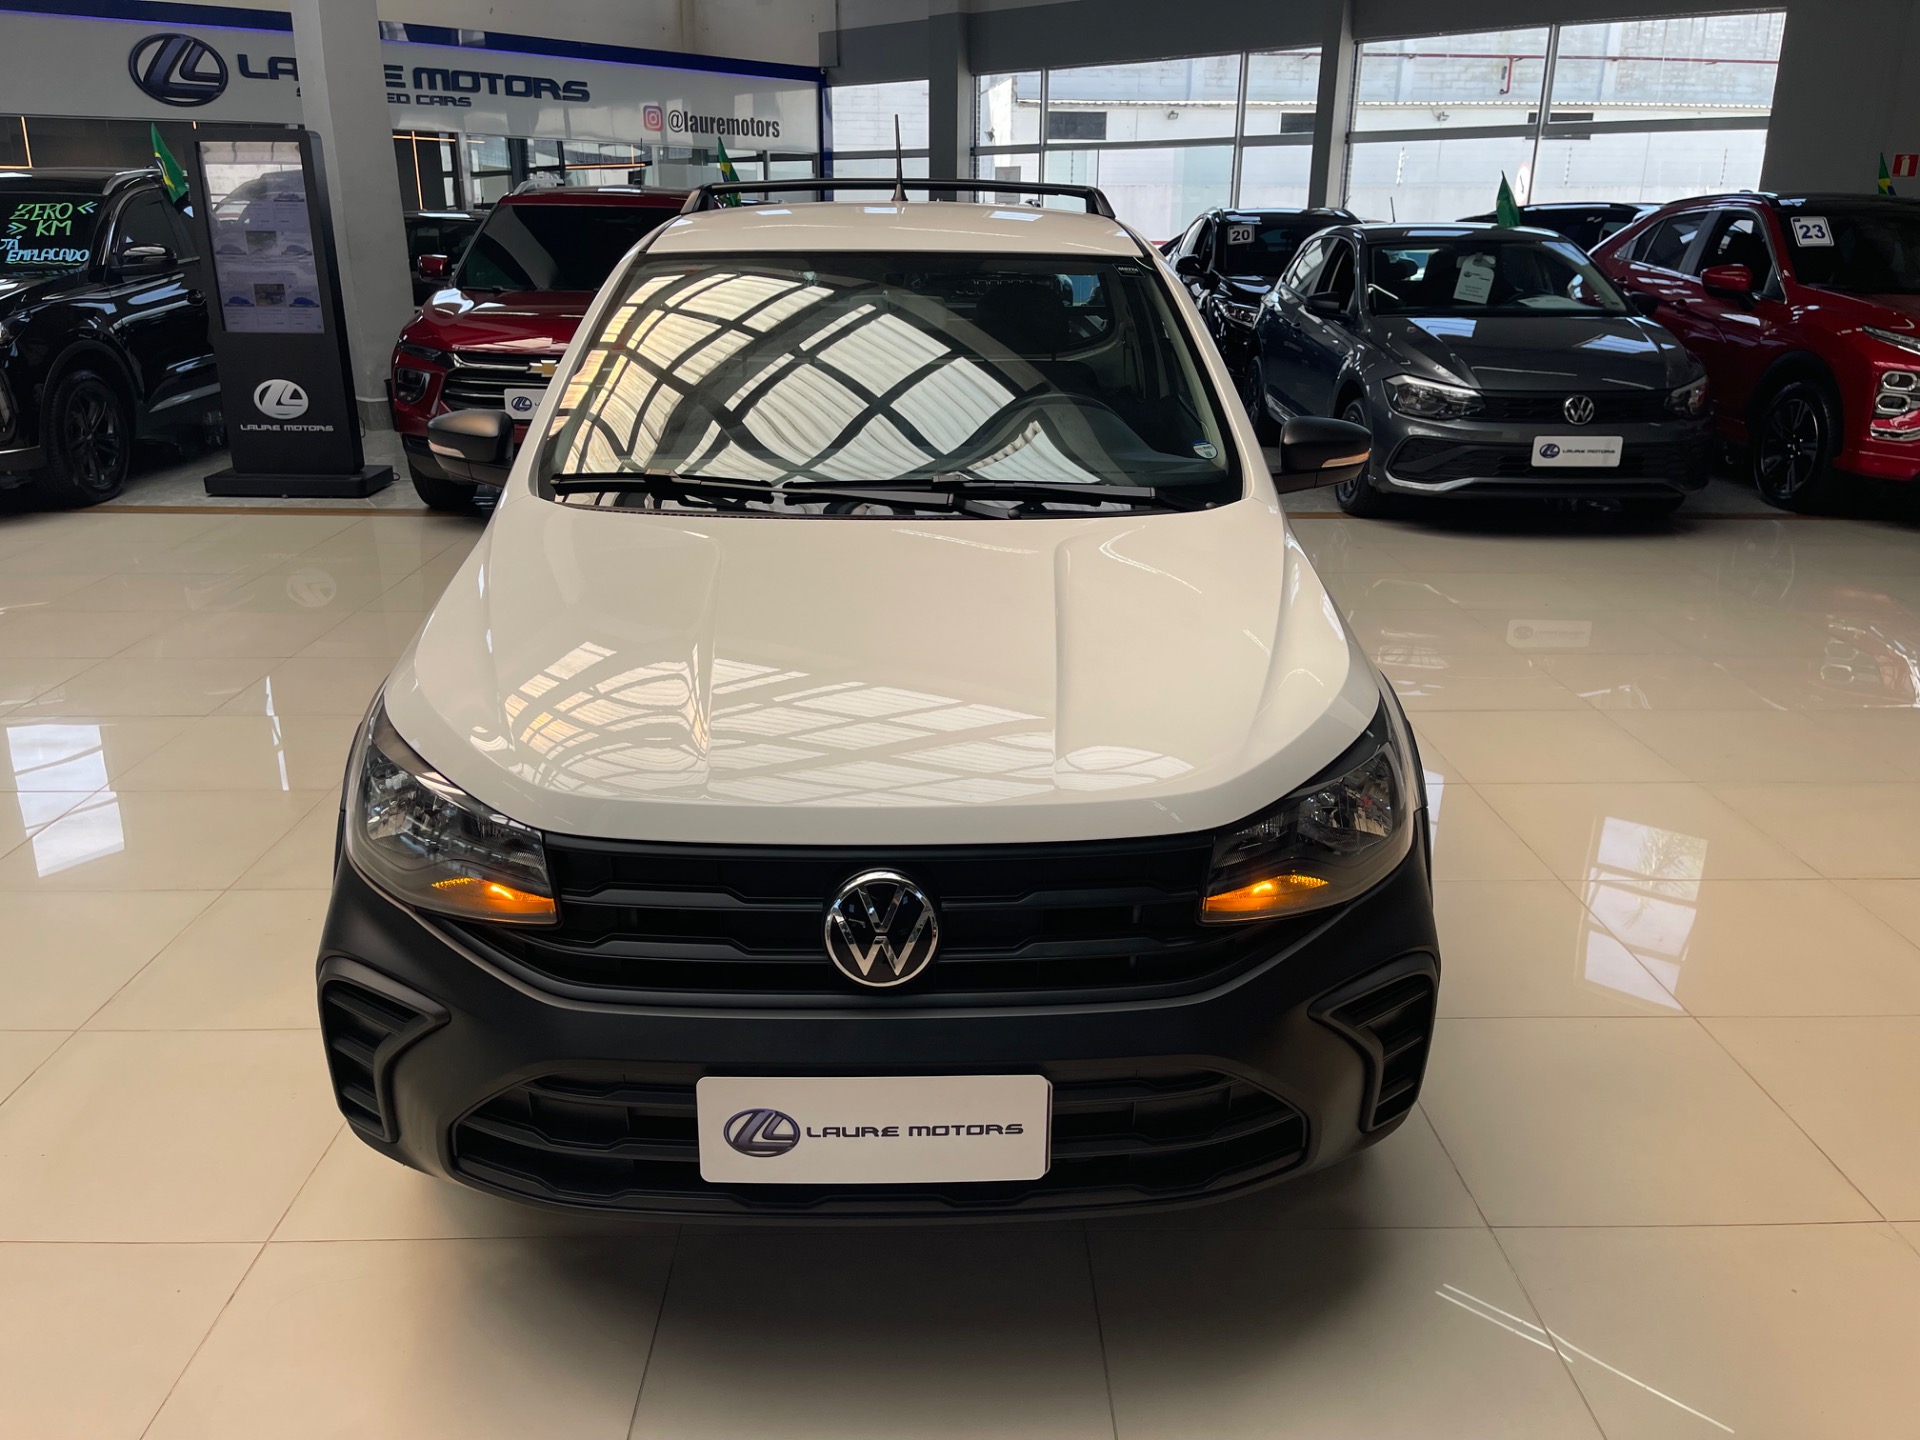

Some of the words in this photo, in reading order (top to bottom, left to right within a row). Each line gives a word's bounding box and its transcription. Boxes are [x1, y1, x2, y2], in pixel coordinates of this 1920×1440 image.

[413, 67, 590, 102] MOTORS
[416, 95, 472, 107] CARS
[668, 110, 780, 138] @lauremotors
[9, 203, 73, 220] ZERO
[36, 220, 72, 236] KM
[1799, 225, 1826, 239] 23
[1232, 230, 1250, 241] 20
[6, 248, 90, 262] EMPLACADO
[284, 424, 334, 432] MOTORS
[806, 1126, 900, 1138] LAURE
[908, 1123, 1024, 1137] MOTORS
